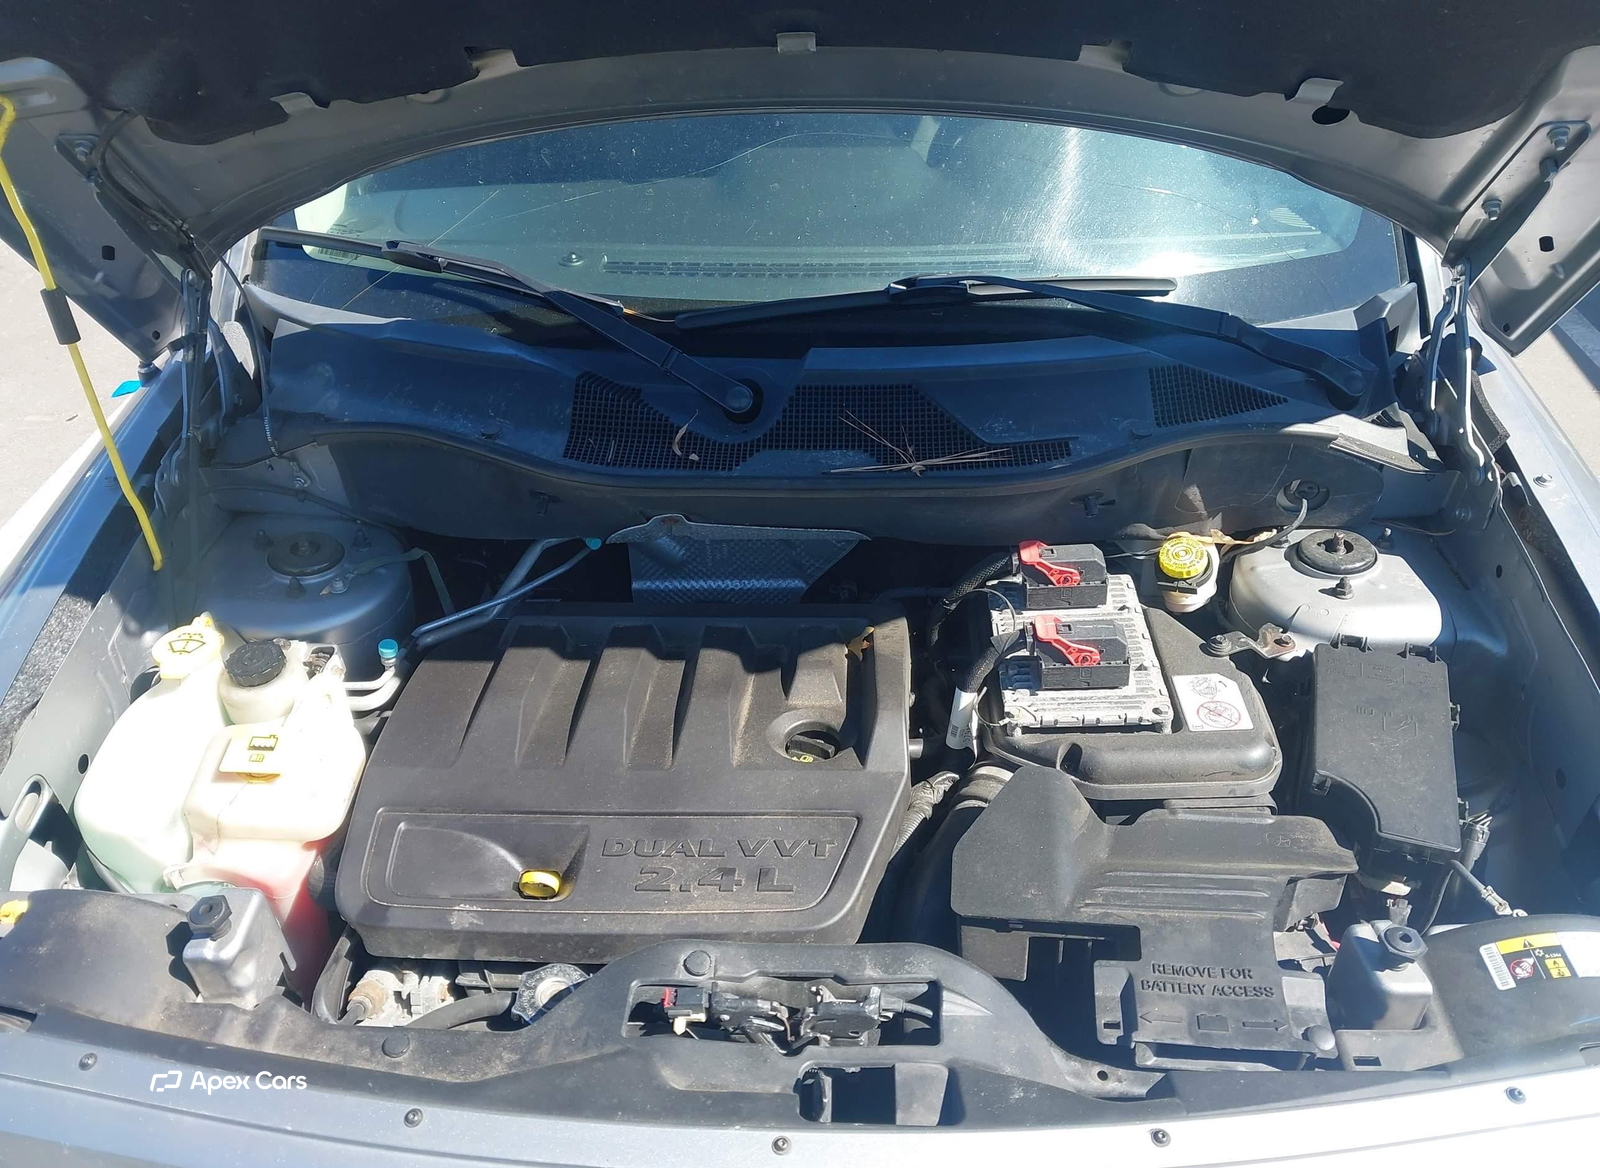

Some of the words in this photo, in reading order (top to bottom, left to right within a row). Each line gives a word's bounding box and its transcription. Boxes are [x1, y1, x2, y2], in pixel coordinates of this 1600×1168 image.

[602, 838, 726, 858] DUAL
[736, 838, 838, 858] VVT
[1151, 962, 1218, 979] REMOVE
[1220, 966, 1254, 980] FOR
[1140, 979, 1207, 996] BATTERY
[1211, 984, 1275, 999] ACCESS
